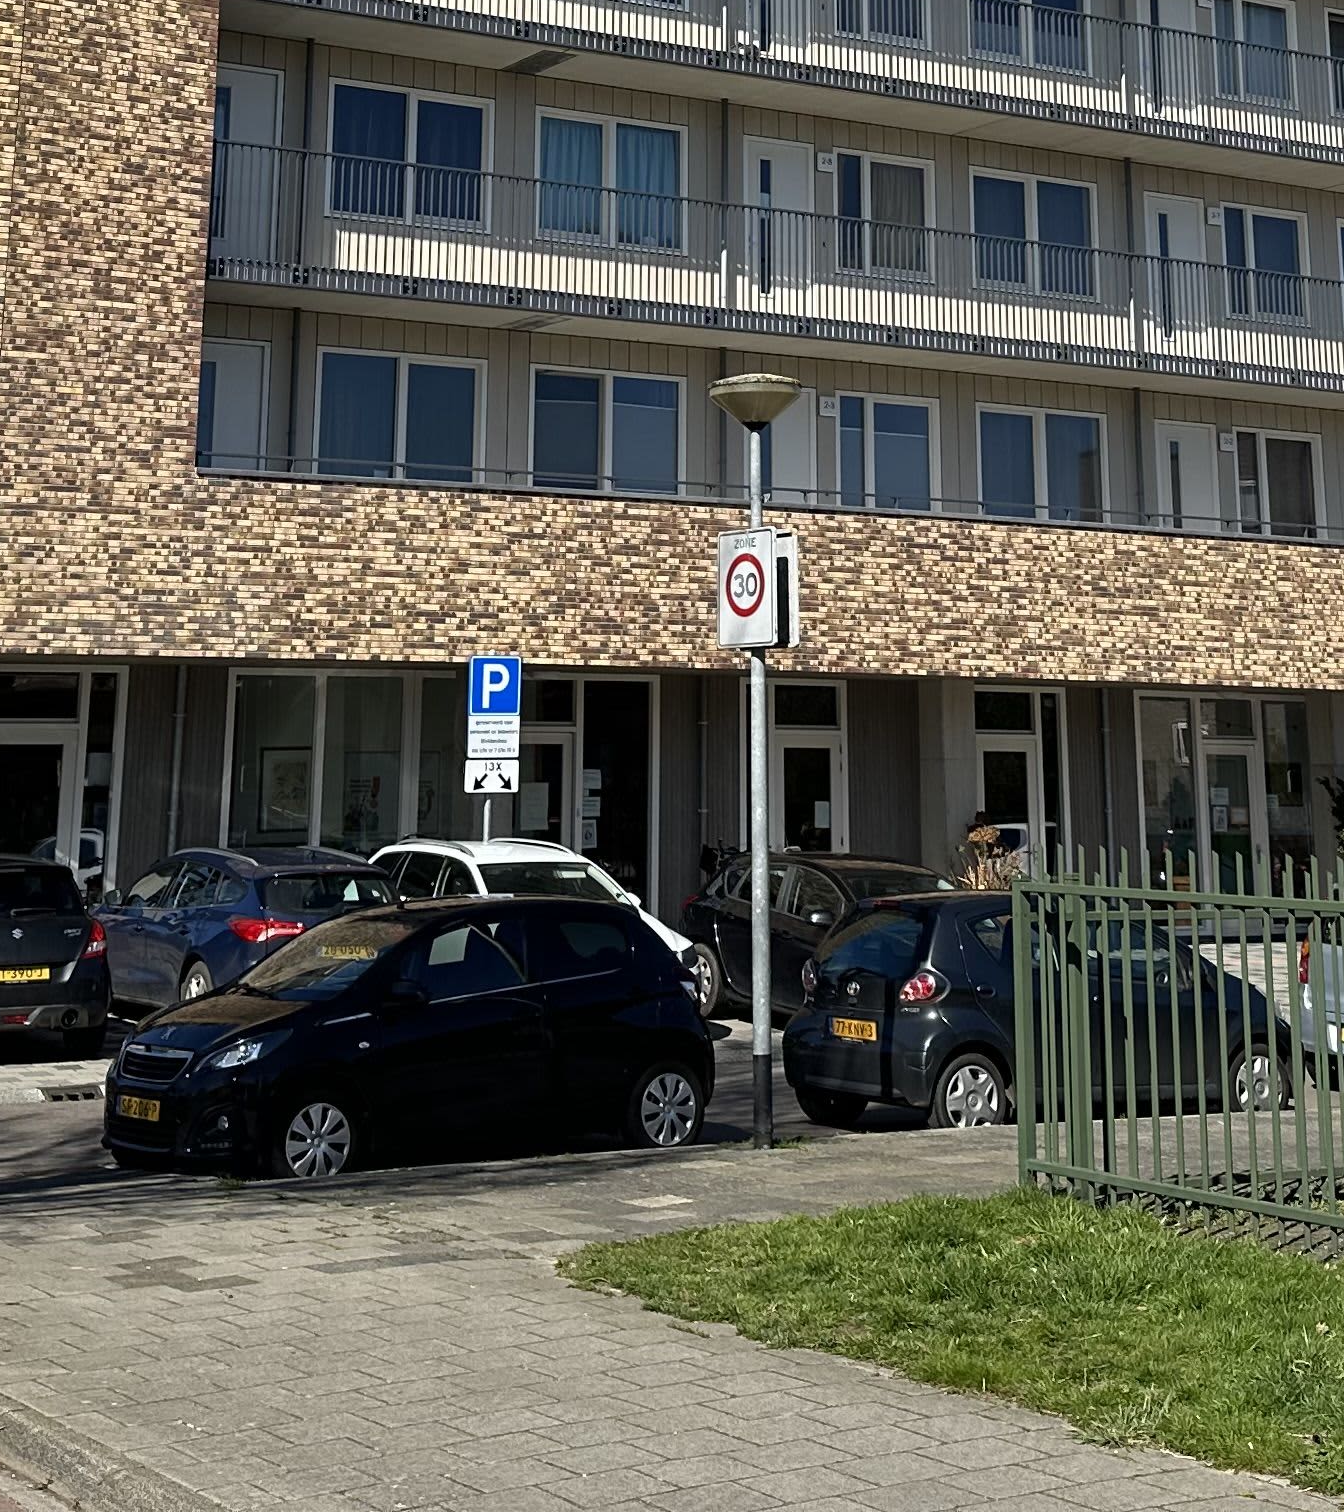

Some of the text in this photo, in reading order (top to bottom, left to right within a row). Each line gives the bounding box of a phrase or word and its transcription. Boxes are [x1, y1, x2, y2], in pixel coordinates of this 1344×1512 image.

[734, 537, 757, 549] ZONE
[733, 572, 758, 598] 30
[482, 663, 510, 709] P
